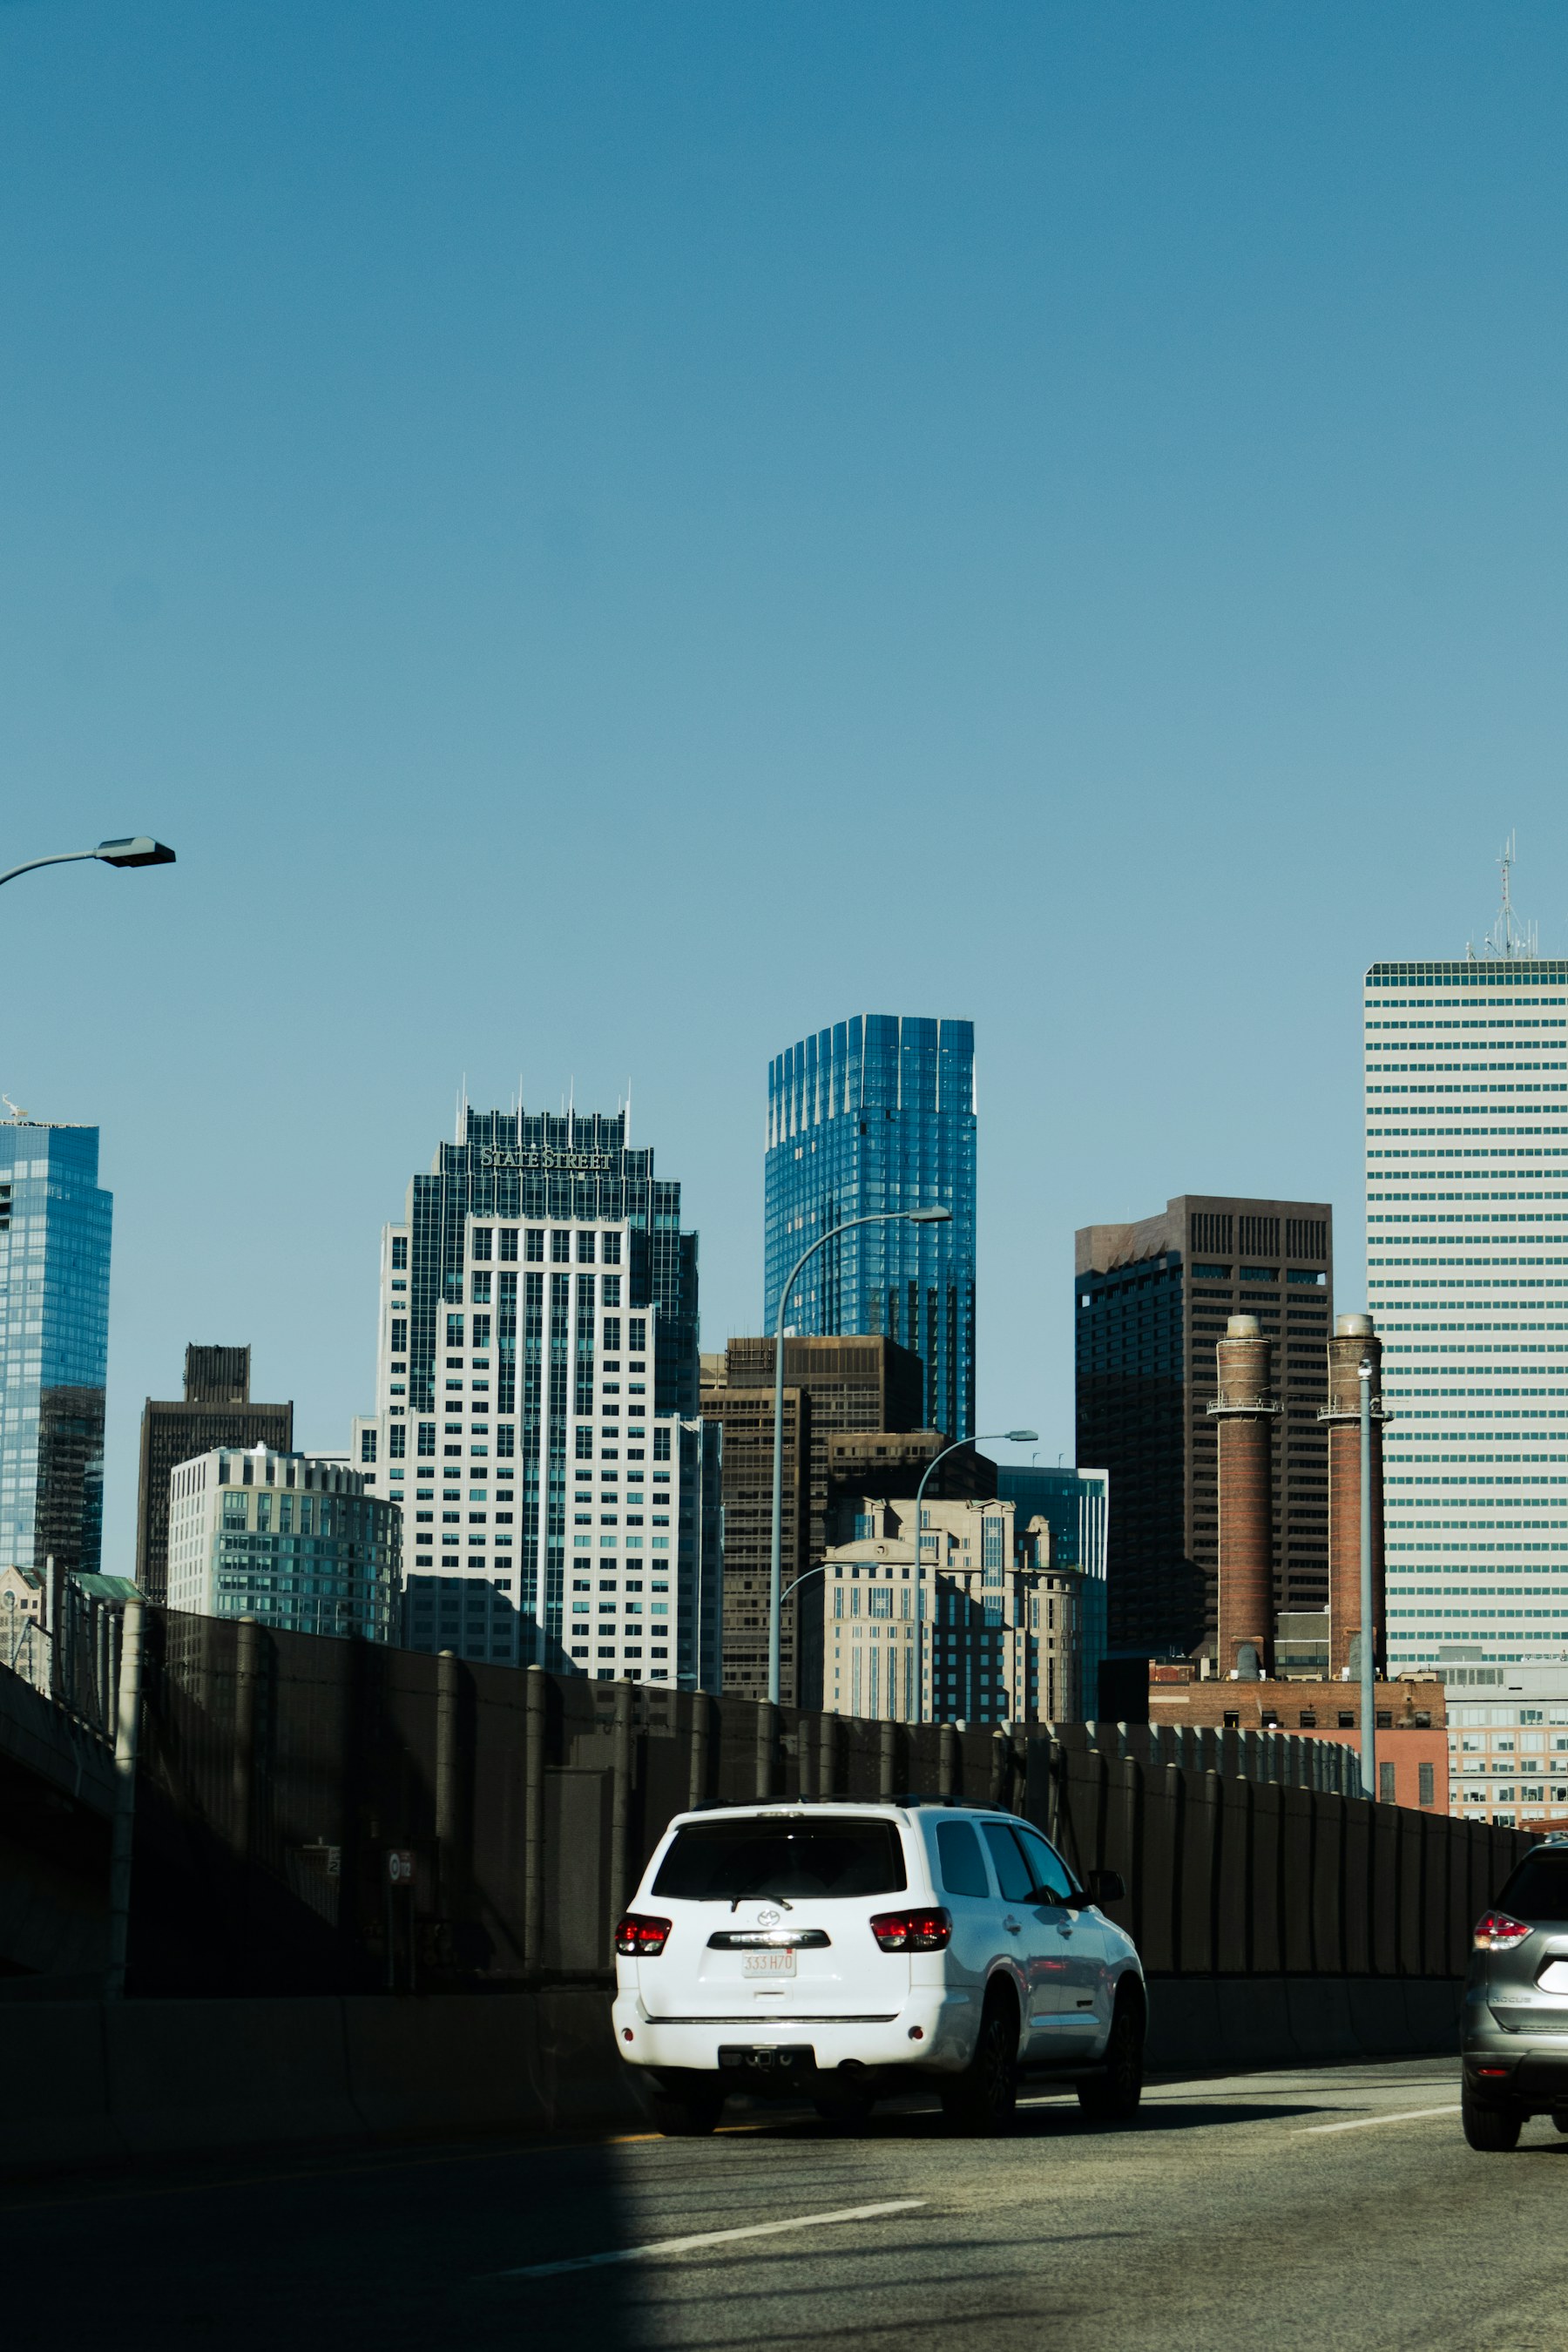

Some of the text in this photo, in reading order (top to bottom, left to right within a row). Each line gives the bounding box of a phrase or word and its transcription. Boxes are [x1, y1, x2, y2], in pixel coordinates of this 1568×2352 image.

[480, 1147, 613, 1170] STATE STREET
[745, 1955, 794, 1970] 333 H70
